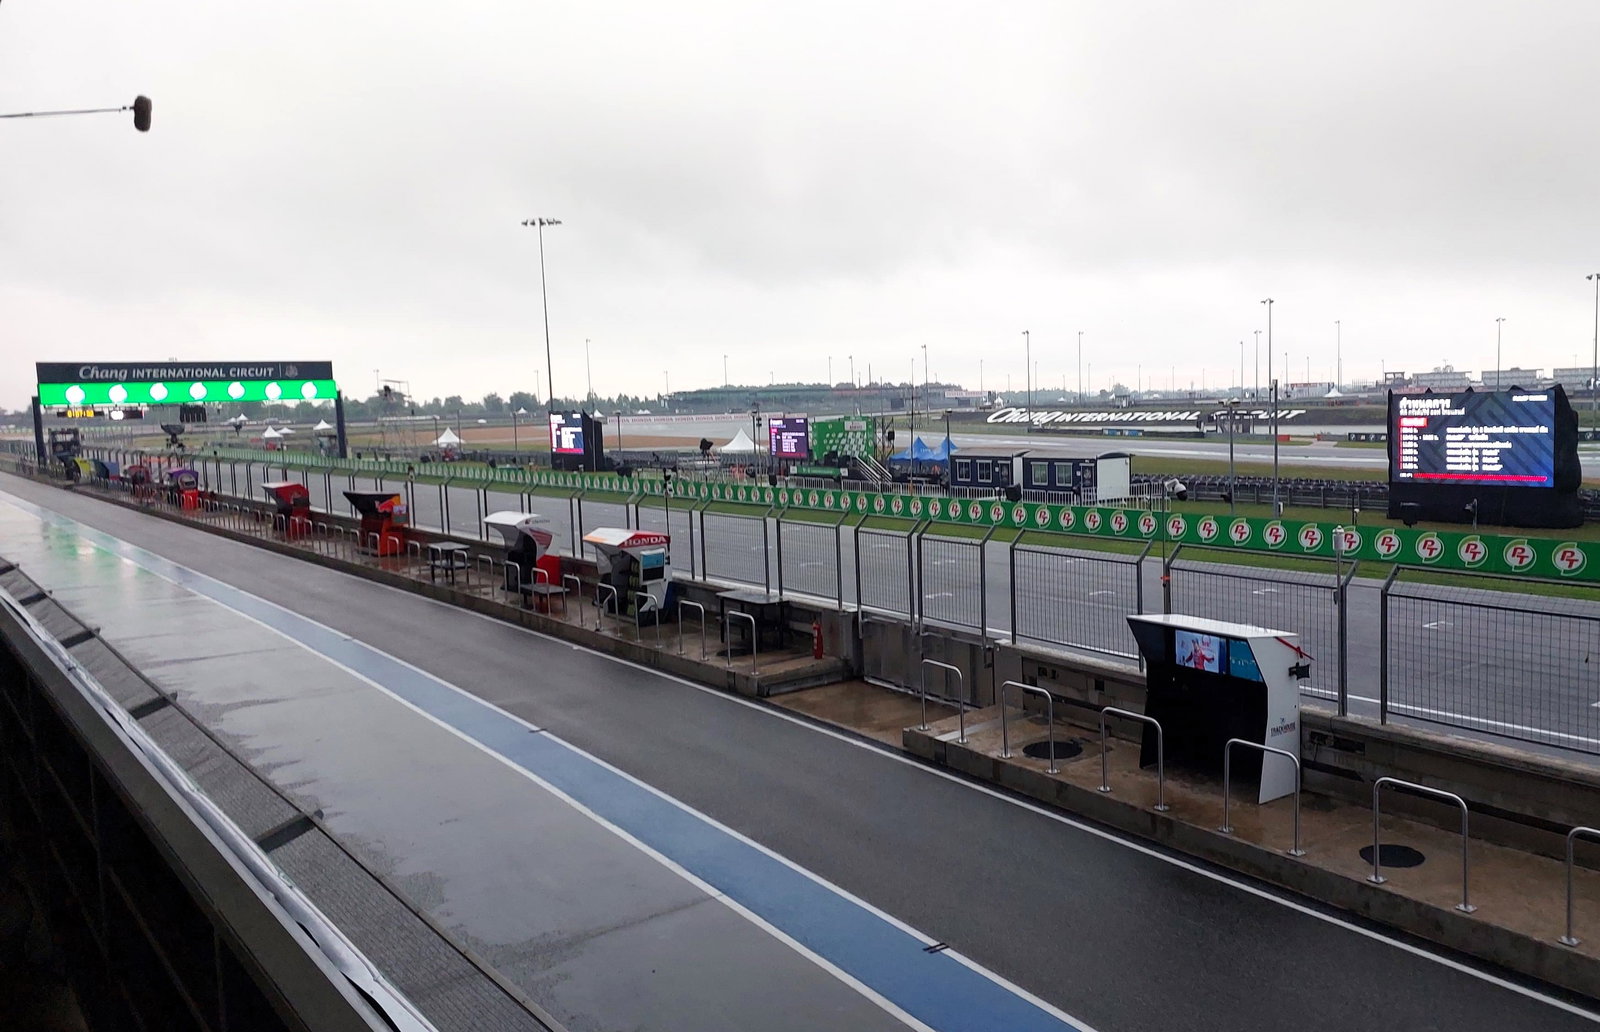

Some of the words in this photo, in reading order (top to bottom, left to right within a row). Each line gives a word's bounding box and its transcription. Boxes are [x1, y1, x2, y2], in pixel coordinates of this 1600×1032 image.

[79, 366, 128, 381] Chang
[132, 368, 226, 380] INTERNATIONAL
[229, 367, 274, 378] CIRCUIT
[986, 407, 1063, 425] Chang
[1057, 410, 1201, 423] INTERNATIONAL
[1016, 510, 1024, 522] PT
[1039, 511, 1048, 524] PT
[1063, 512, 1073, 526] PT
[1088, 514, 1099, 528] PT
[1114, 516, 1125, 531] PT
[1143, 518, 1154, 532] PT
[1171, 520, 1183, 535] PT
[1202, 522, 1214, 537] PT
[1235, 524, 1248, 540] PT
[624, 536, 667, 547] HONDA
[1269, 527, 1282, 543] PT
[1304, 530, 1318, 547] PT
[1343, 533, 1357, 549] PT
[1380, 536, 1397, 553] PT
[1422, 539, 1439, 557] PT
[1465, 542, 1482, 561] PT
[1511, 546, 1530, 565] PT
[1560, 550, 1579, 569] PT
